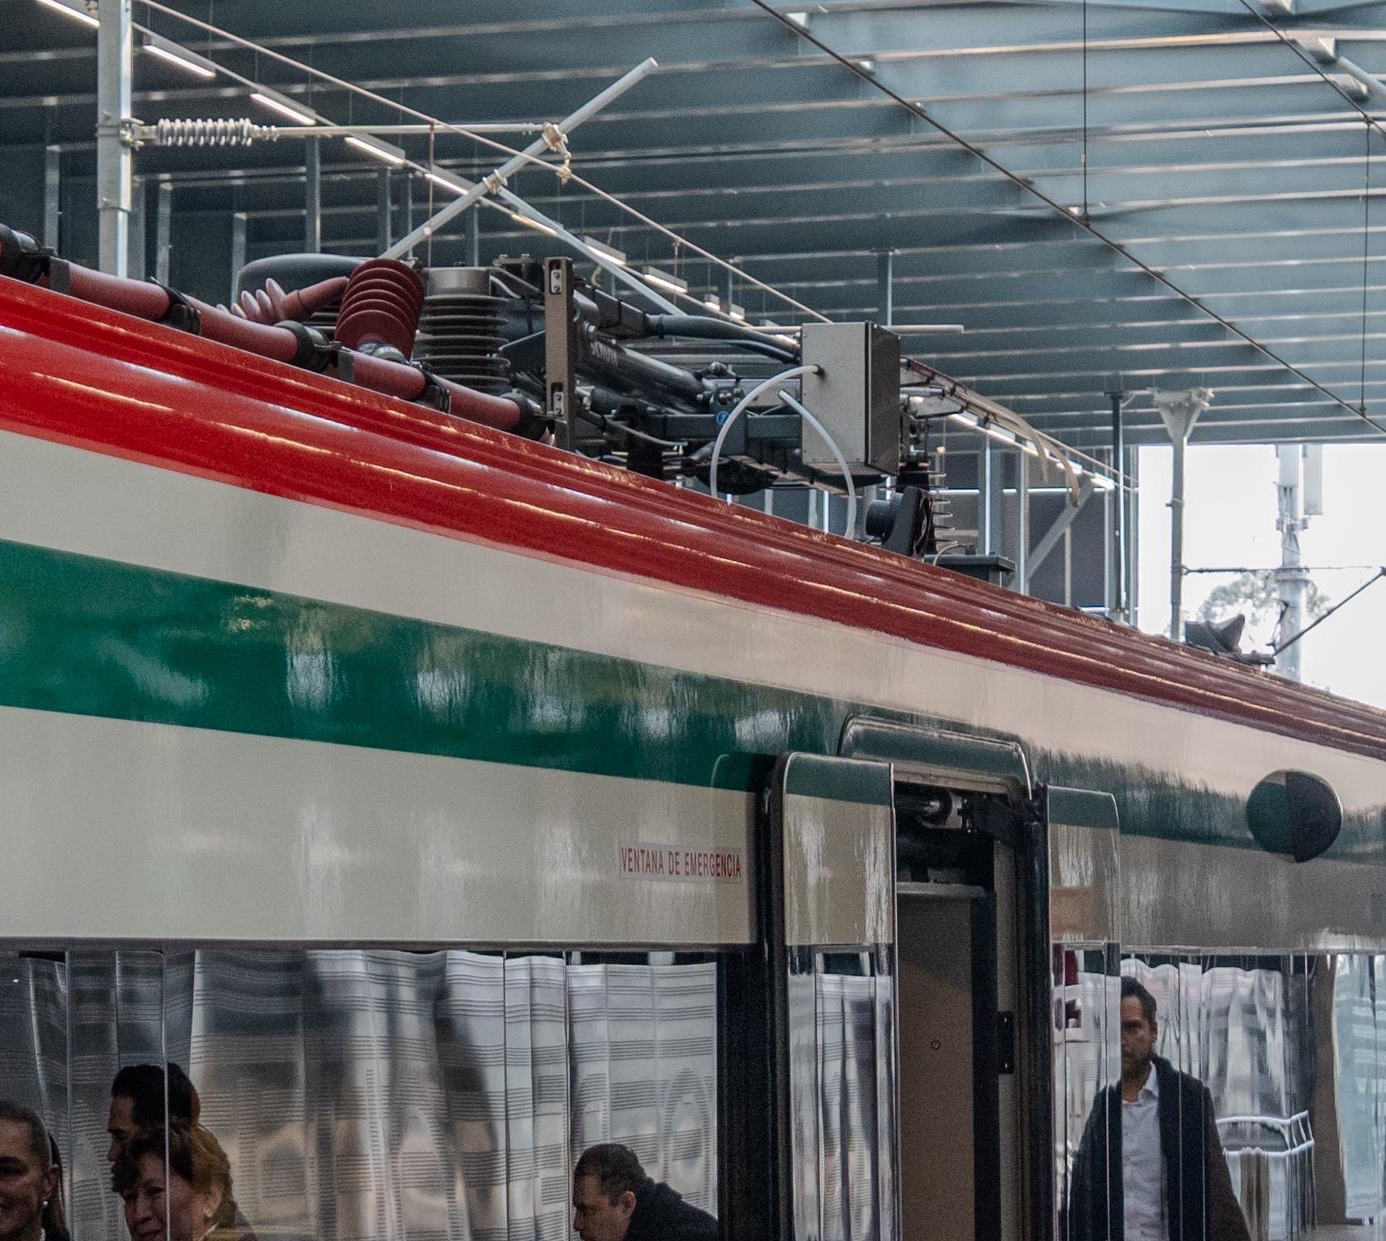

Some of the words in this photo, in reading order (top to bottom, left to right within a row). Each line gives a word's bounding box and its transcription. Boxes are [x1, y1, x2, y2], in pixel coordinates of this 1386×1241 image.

[621, 848, 664, 874] VENTANA
[668, 851, 680, 875] DE
[685, 852, 742, 878] EMERGENCIA
